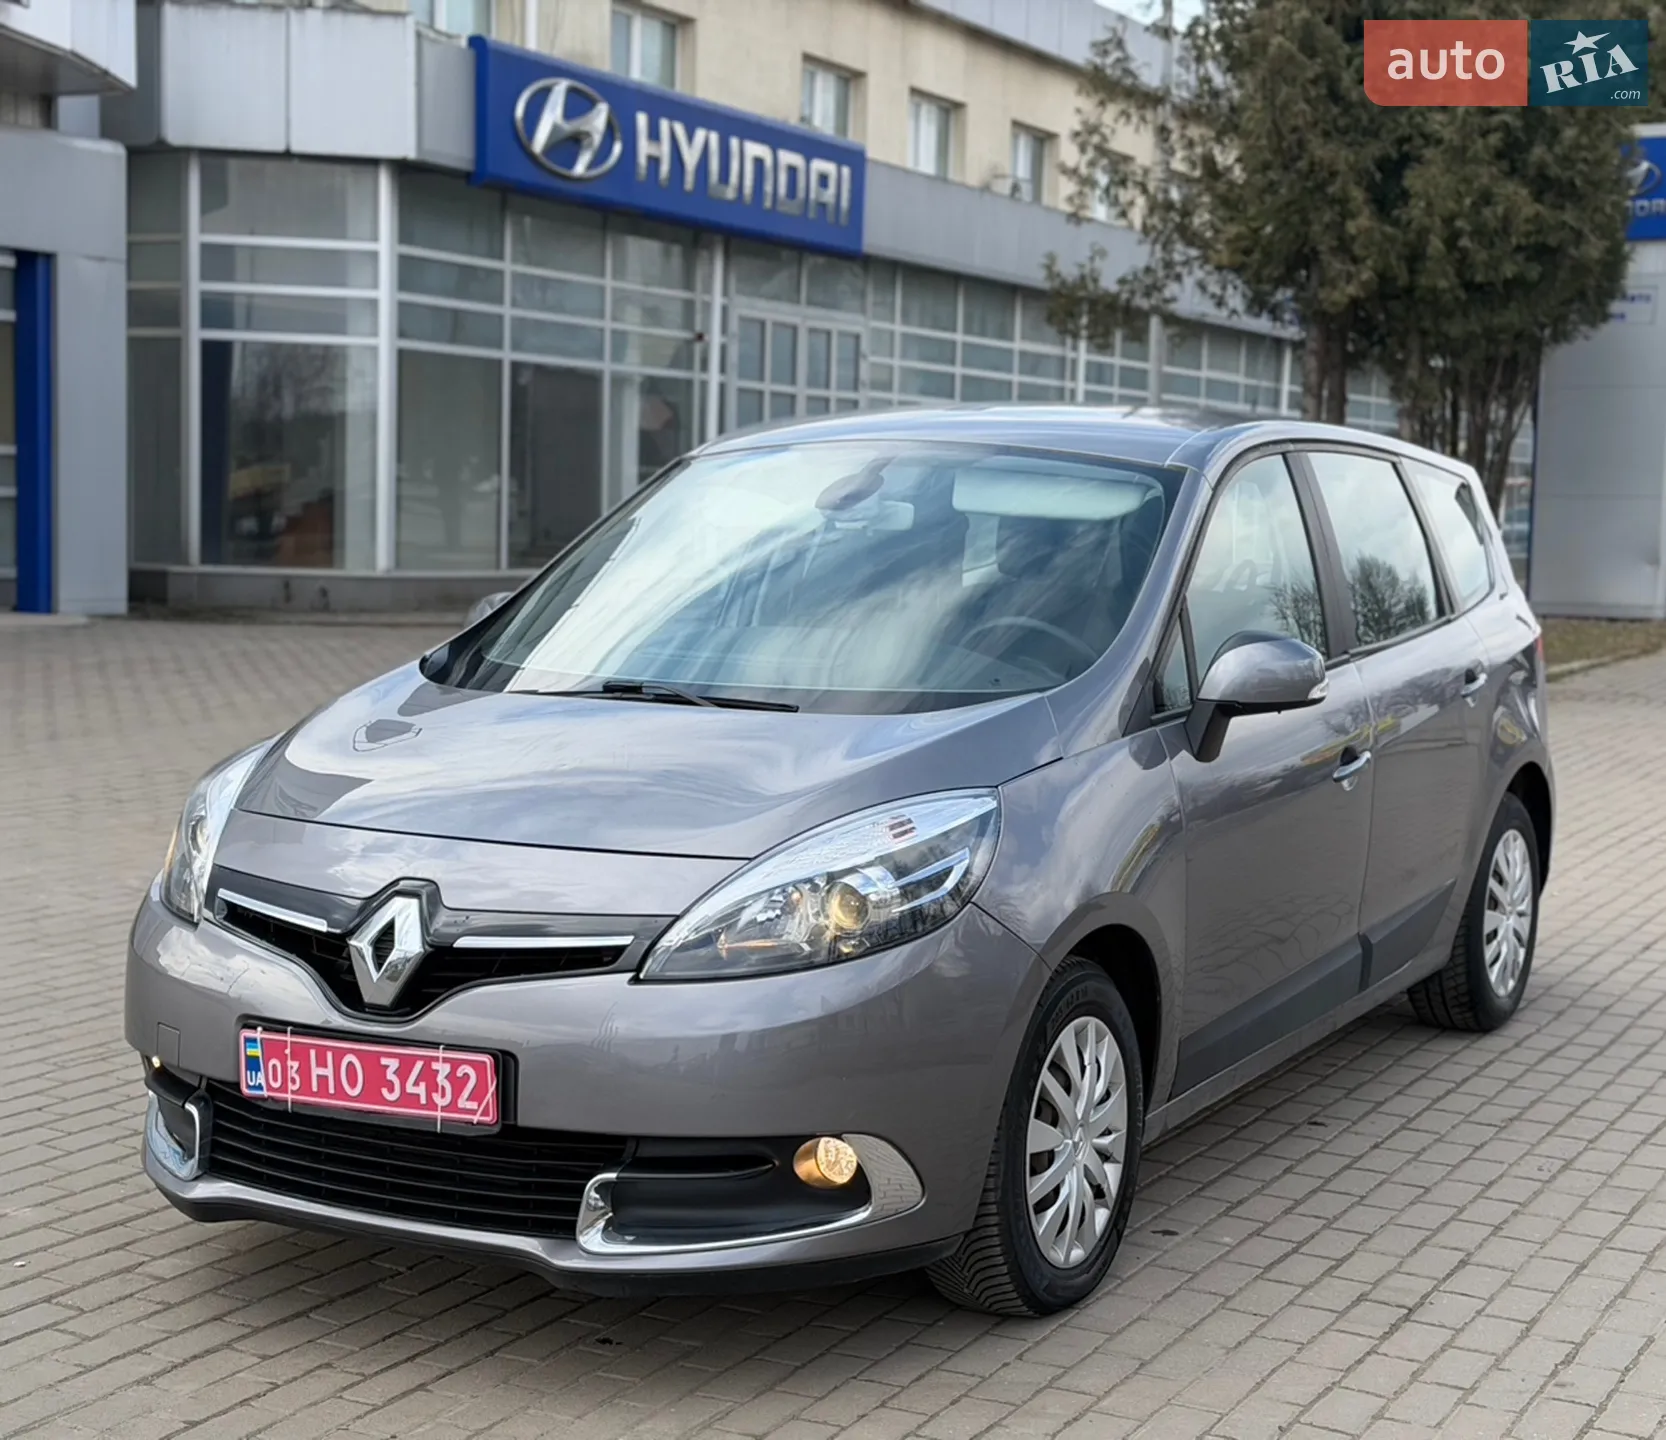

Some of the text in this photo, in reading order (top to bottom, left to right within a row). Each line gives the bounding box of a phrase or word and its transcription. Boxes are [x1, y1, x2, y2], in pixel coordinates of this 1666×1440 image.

[635, 111, 852, 228] HYUNDAI
[247, 1070, 264, 1087] UA
[268, 1057, 301, 1091] 03
[380, 1056, 479, 1110] 3432
